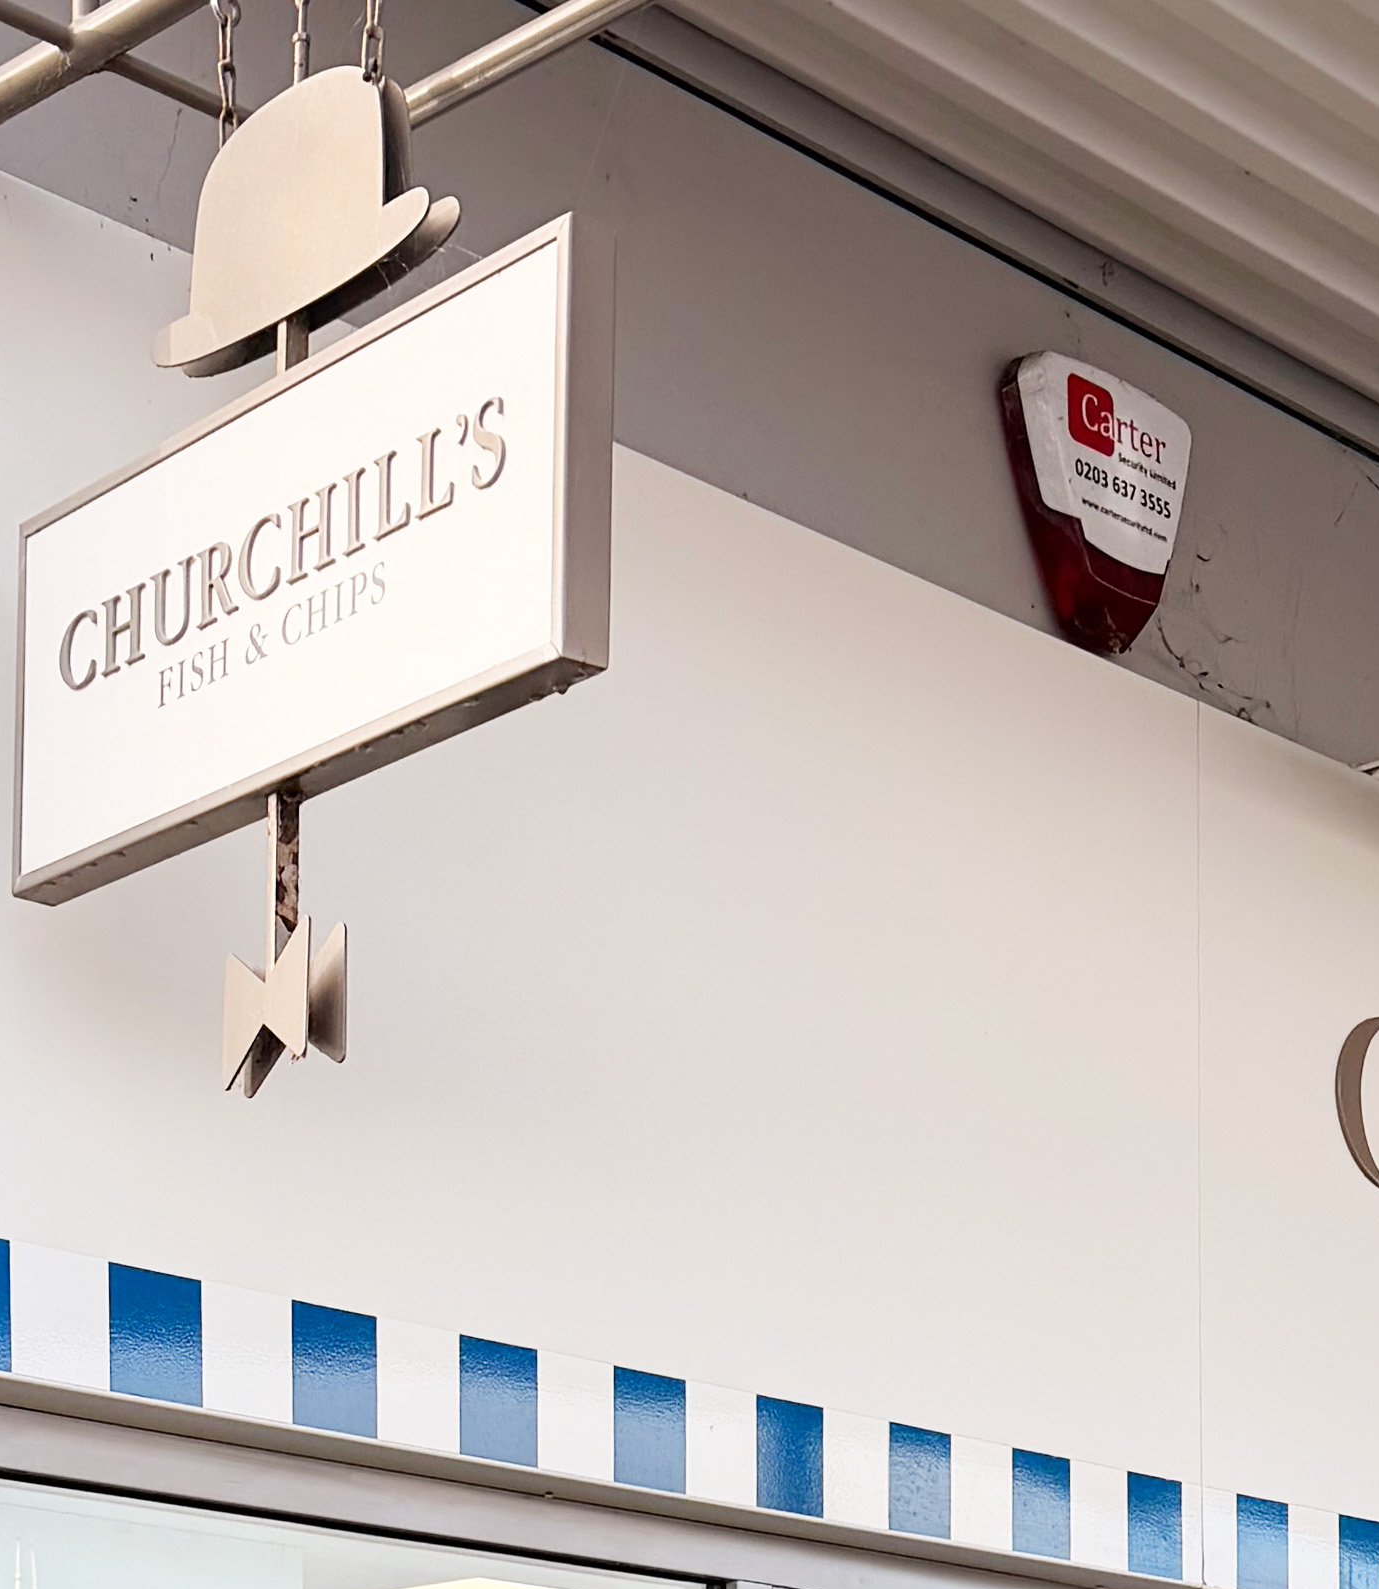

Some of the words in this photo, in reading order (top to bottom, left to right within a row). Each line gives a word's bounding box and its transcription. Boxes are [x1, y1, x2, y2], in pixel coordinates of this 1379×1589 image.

[1080, 393, 1167, 464] Carter
[1075, 458, 1109, 488] 0203
[1112, 475, 1136, 500] 637
[1140, 488, 1171, 519] 3555
[58, 396, 507, 691] CHURCHILL'S
[157, 639, 229, 709] FISH
[243, 624, 270, 665] &
[280, 561, 387, 646] CHIPS
